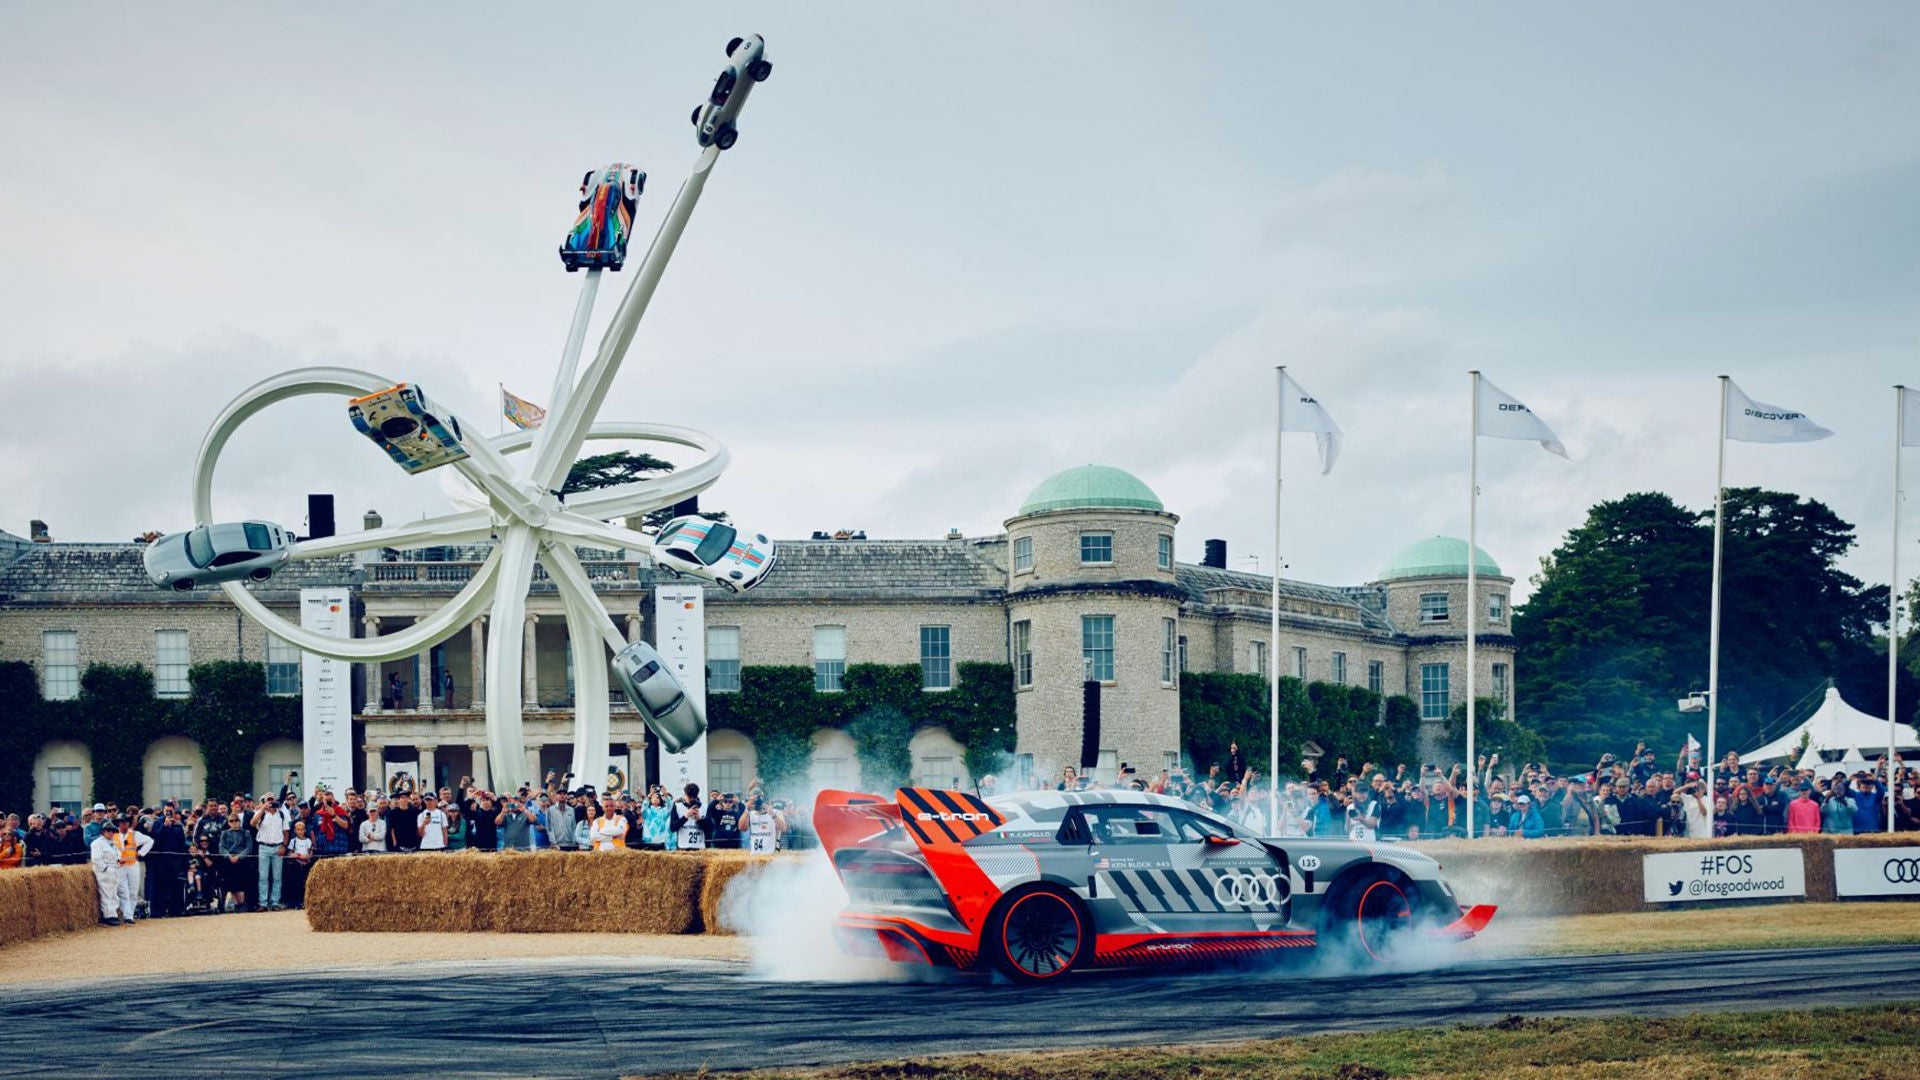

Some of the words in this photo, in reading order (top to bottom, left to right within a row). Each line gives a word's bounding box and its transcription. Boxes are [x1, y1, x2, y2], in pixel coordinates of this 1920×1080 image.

[917, 811, 990, 821] e-tron
[1302, 859, 1316, 867] 135
[1700, 854, 1753, 875] #FOS
[1689, 876, 1785, 896] @fosgoodwood
